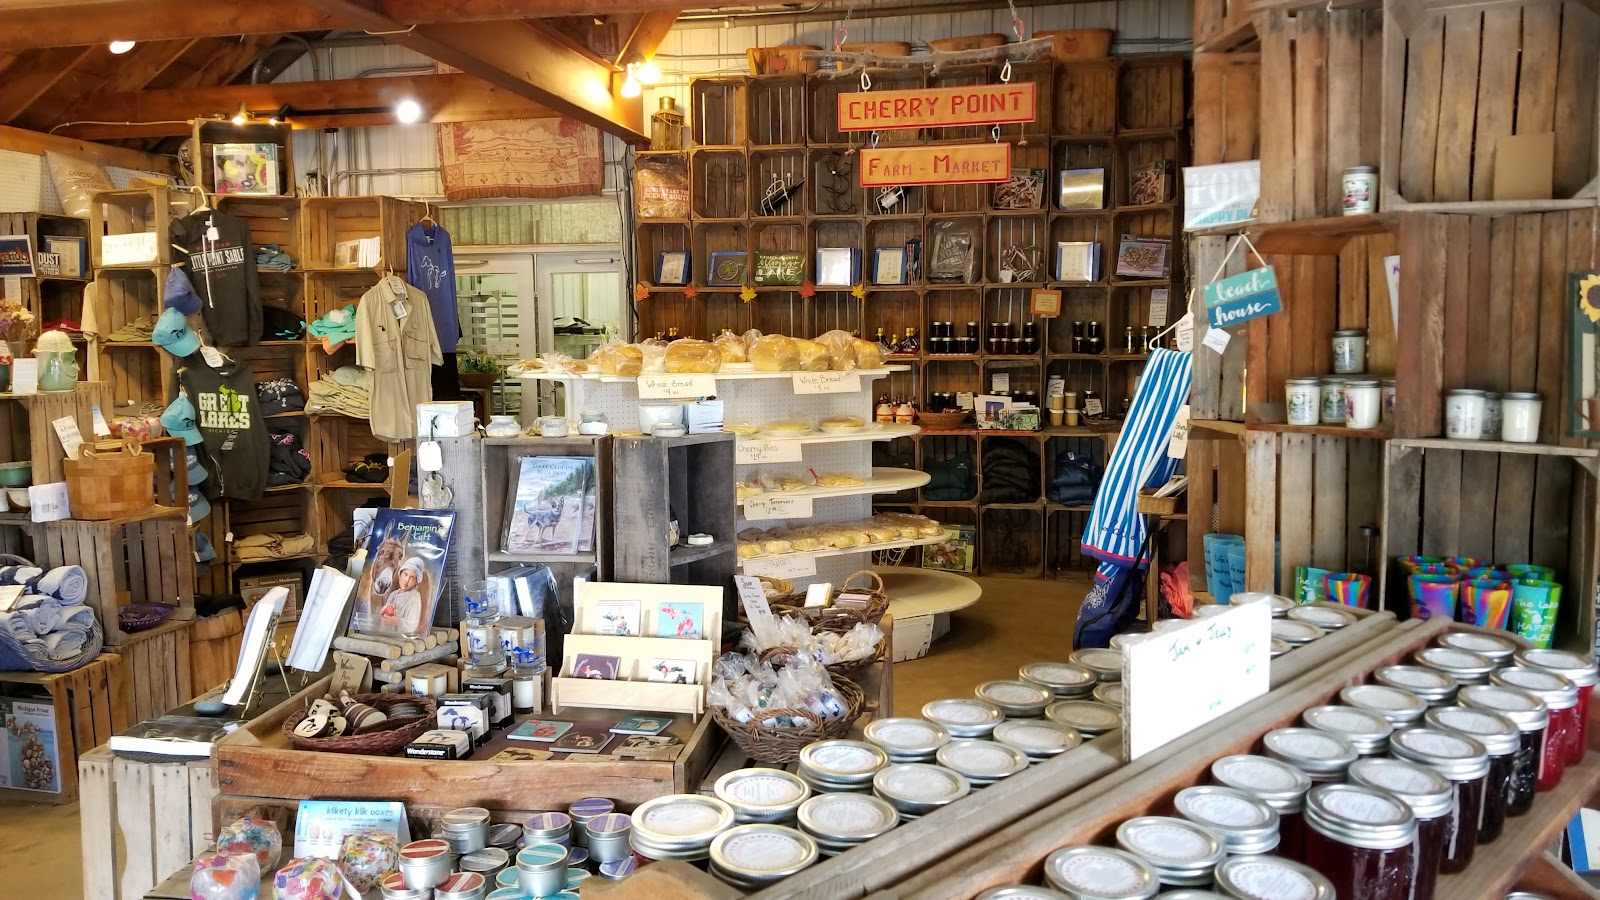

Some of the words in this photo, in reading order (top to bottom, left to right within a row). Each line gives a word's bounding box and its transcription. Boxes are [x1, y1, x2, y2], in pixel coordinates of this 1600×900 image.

[849, 97, 939, 120] CHERRY
[951, 91, 1024, 115] POINT
[38, 252, 60, 266] DUST
[224, 247, 244, 264] SABLE
[1214, 272, 1271, 303] beach
[1213, 302, 1272, 327] house
[645, 380, 669, 389] Wheat
[671, 379, 693, 388] Bread
[820, 374, 841, 384] Bread
[199, 410, 251, 430] LAKES
[737, 444, 762, 454] Cherry
[763, 443, 778, 452] Pies
[549, 463, 573, 471] CLOUDS
[749, 500, 766, 509] Cherry
[768, 497, 795, 506] Turnovers
[397, 521, 444, 533] Benjamin's
[412, 532, 432, 542] Gift
[445, 550, 459, 578] FRUIT
[1514, 598, 1535, 608] The
[1207, 622, 1232, 641] Jelly
[1517, 621, 1555, 632] HAPPY
[1517, 631, 1551, 642] PLACE
[17, 705, 36, 713] Michigan
[36, 706, 49, 714] Proud
[406, 747, 446, 756] Wonderstone
